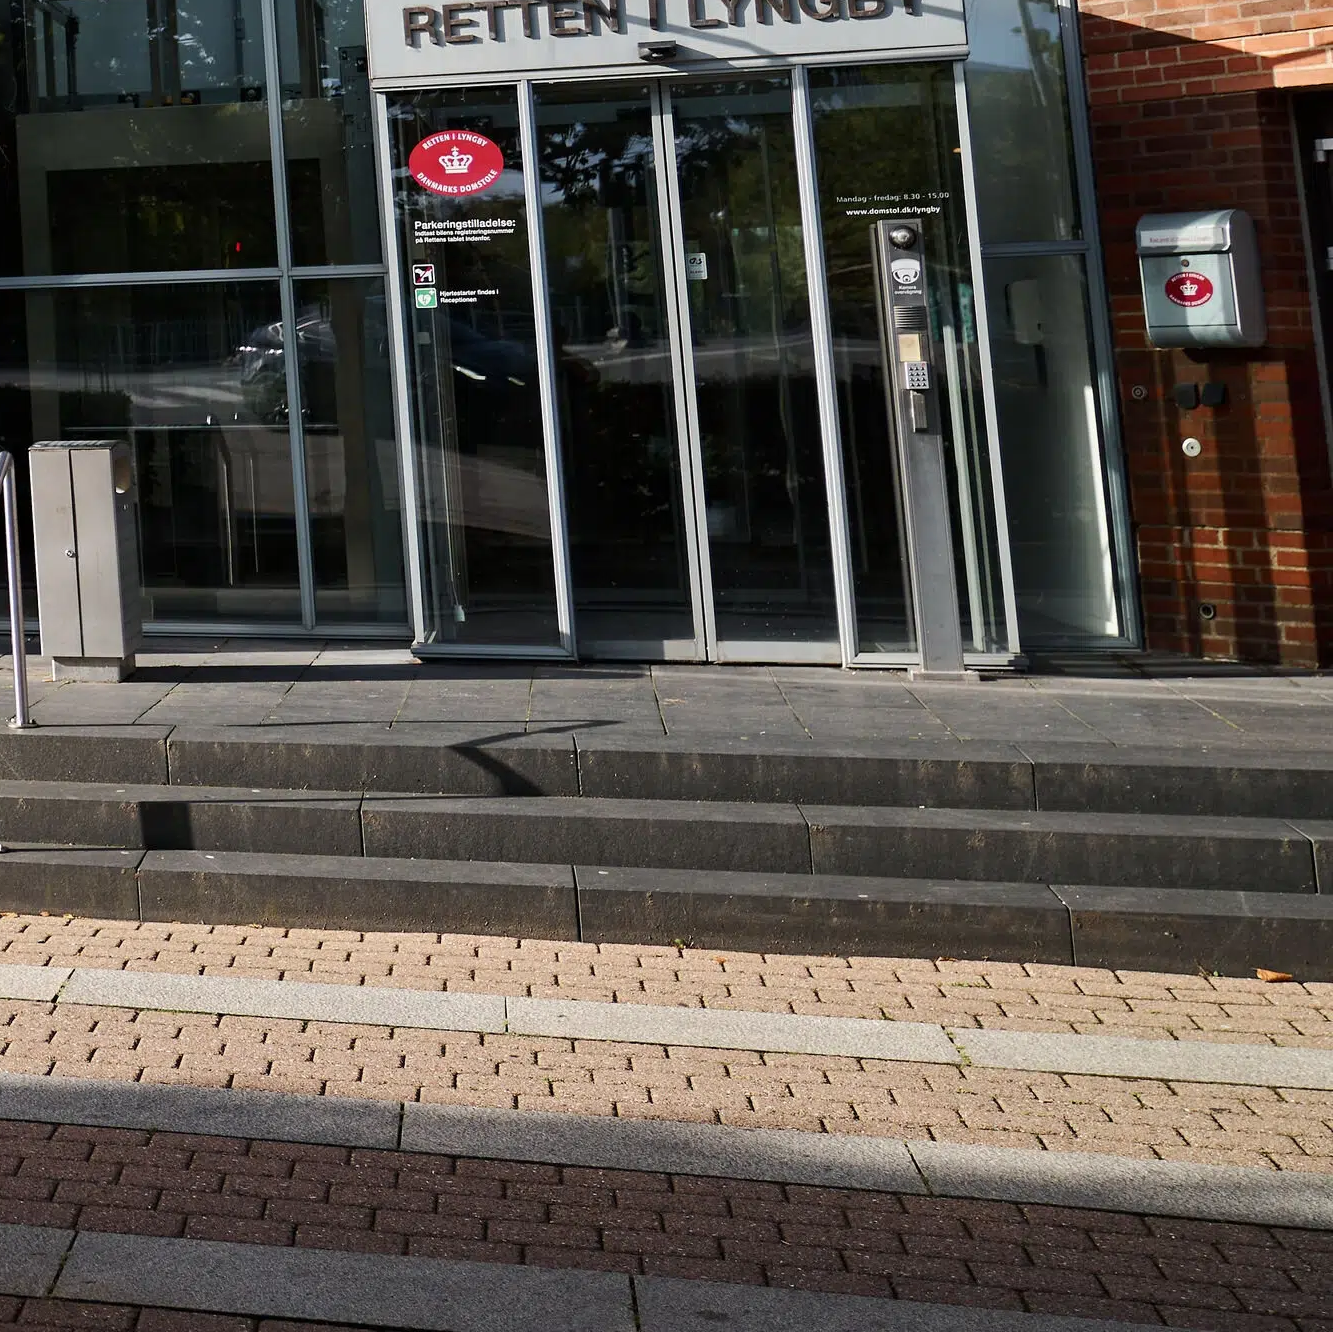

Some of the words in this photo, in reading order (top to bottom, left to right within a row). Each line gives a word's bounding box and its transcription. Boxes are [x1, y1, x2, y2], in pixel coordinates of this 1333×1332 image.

[422, 133, 450, 150] RETTEN
[458, 133, 488, 147] LYNGBY
[416, 172, 458, 193] DANMARKS
[460, 169, 498, 193] DOMSTOLE
[874, 194, 902, 202] fredag:
[846, 206, 941, 216] www.domstol.dk/lyngby
[414, 218, 516, 230] Parkeringstilladelse:
